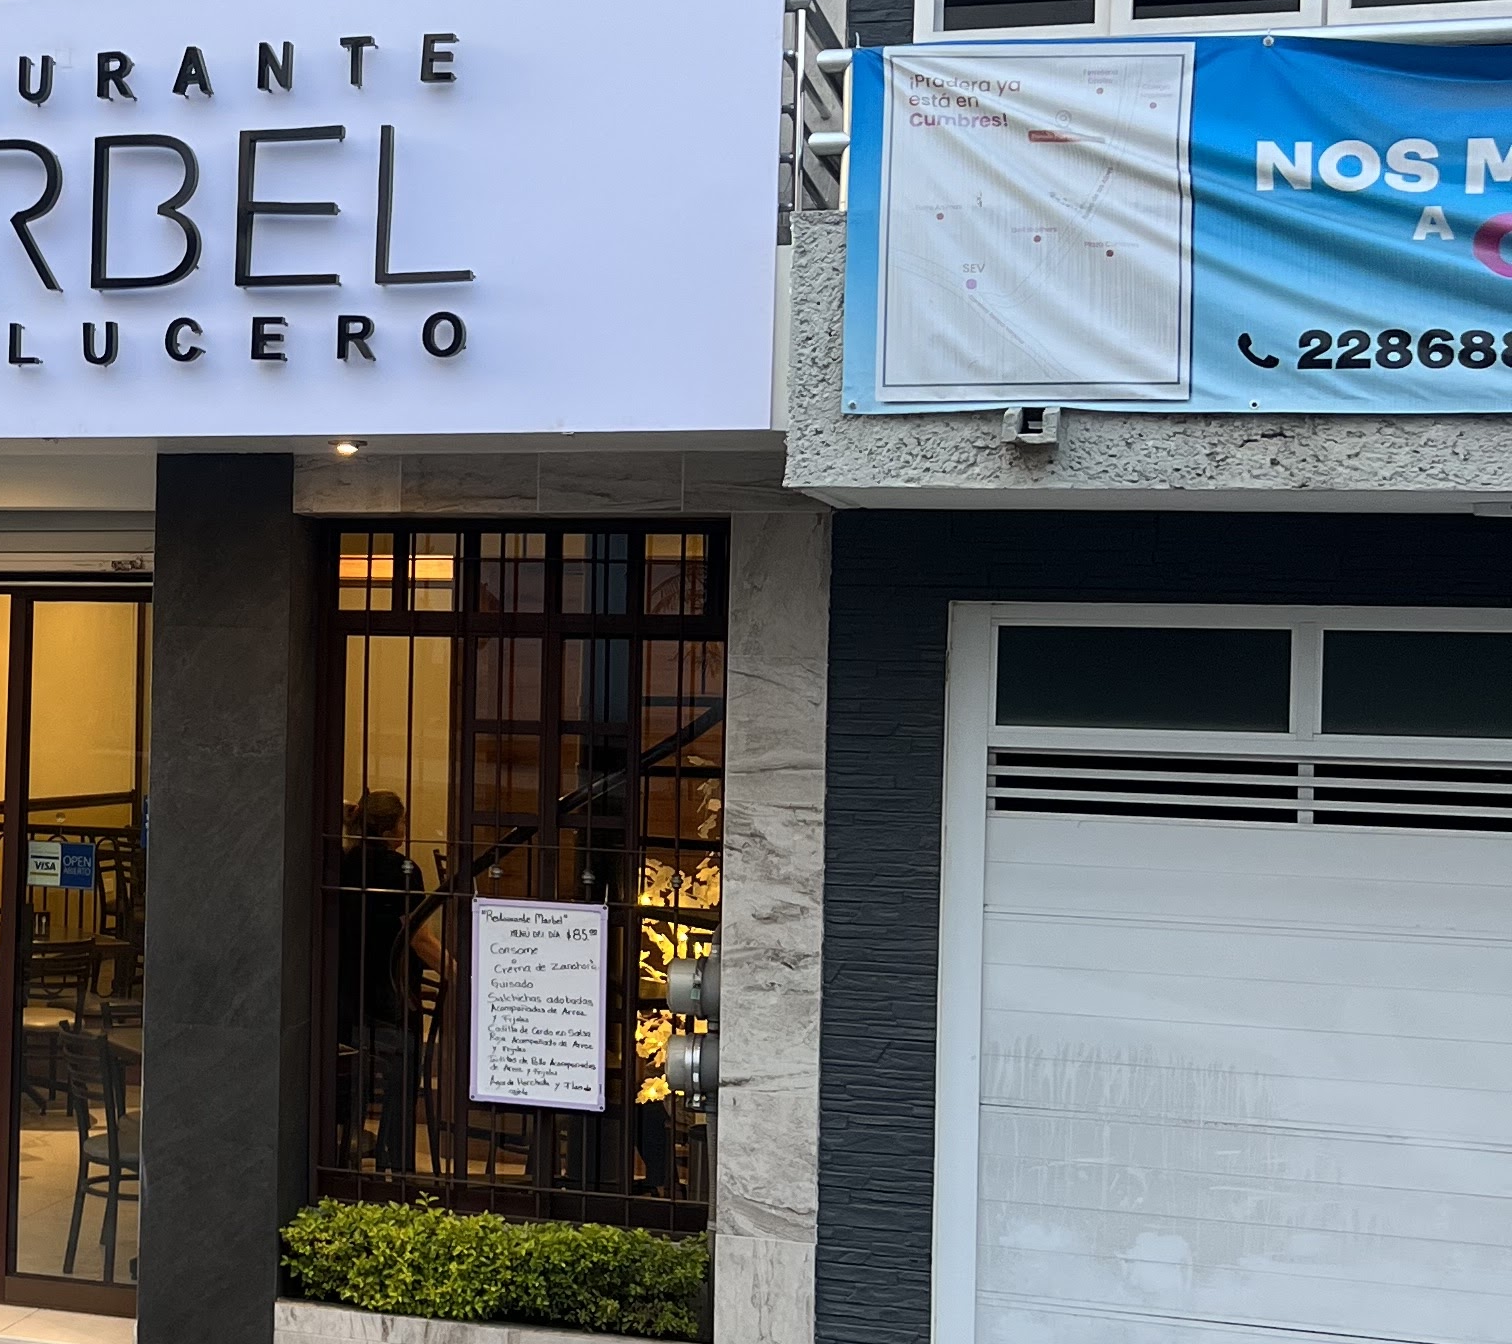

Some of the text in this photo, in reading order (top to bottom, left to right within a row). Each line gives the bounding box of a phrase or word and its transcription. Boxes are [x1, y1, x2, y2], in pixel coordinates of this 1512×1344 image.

[997, 79, 1021, 96] ya
[909, 93, 979, 108] está en
[909, 112, 1008, 128] Cumbres!
[1256, 138, 1439, 193] NOS
[1413, 206, 1455, 240] A
[963, 263, 985, 273] SEV
[8, 311, 467, 367] LUCERO
[1297, 329, 1512, 369] 22868
[33, 860, 57, 871] VISA
[62, 855, 92, 867] OPEN
